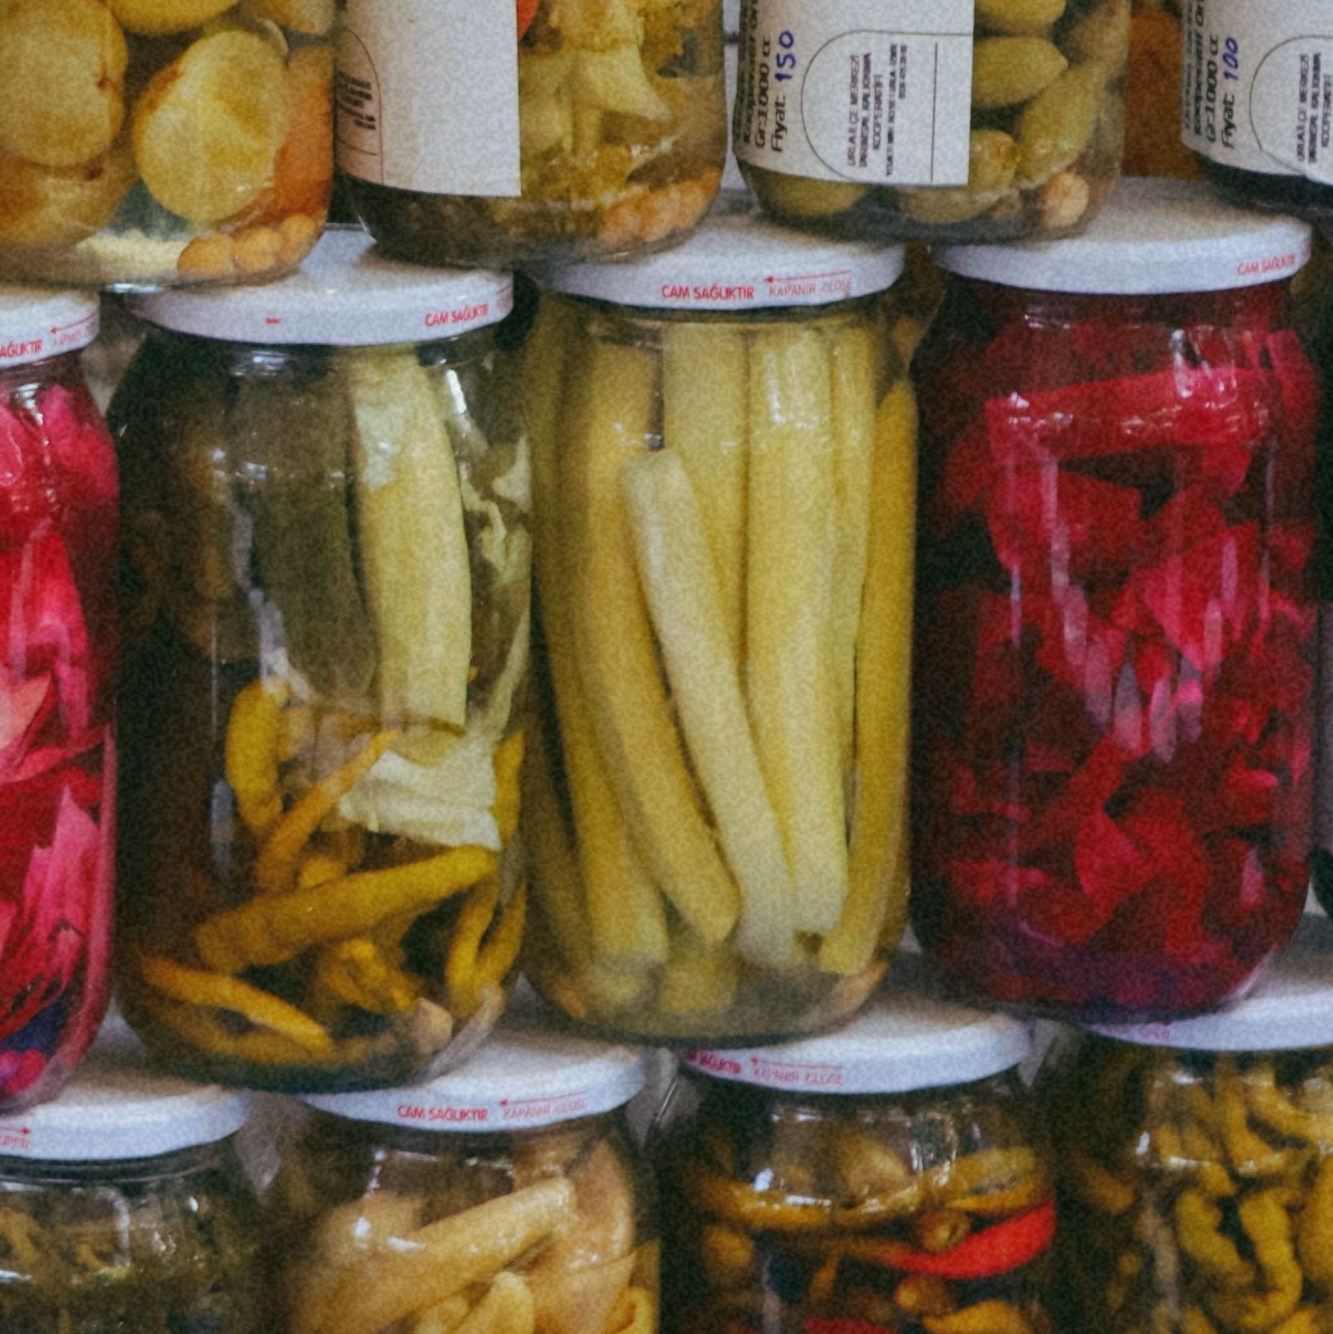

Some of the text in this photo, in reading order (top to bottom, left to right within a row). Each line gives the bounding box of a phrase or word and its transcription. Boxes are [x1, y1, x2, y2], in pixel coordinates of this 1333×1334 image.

[762, 35, 771, 57] cc
[774, 30, 797, 82] 150
[1222, 36, 1239, 81] 100
[771, 94, 788, 153] Fiyat:
[661, 284, 690, 299] CAM
[424, 312, 449, 327] CAM
[397, 1104, 425, 1119] CAM
